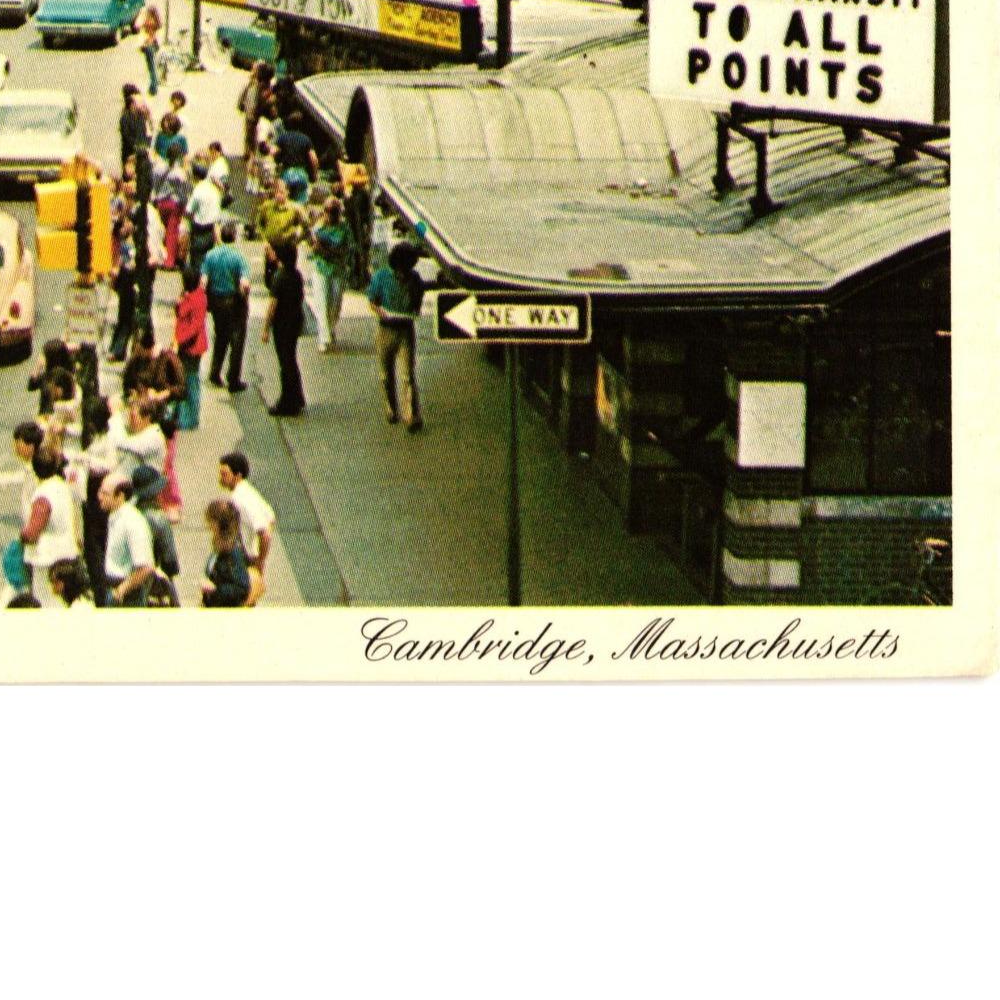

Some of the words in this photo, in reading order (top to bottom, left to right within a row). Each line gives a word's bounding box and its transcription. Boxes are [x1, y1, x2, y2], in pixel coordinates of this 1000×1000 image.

[693, 1, 750, 43] TO
[783, 10, 882, 55] ALL
[688, 49, 883, 104] POINTS
[473, 307, 516, 327] ONE
[529, 308, 573, 326] WAY
